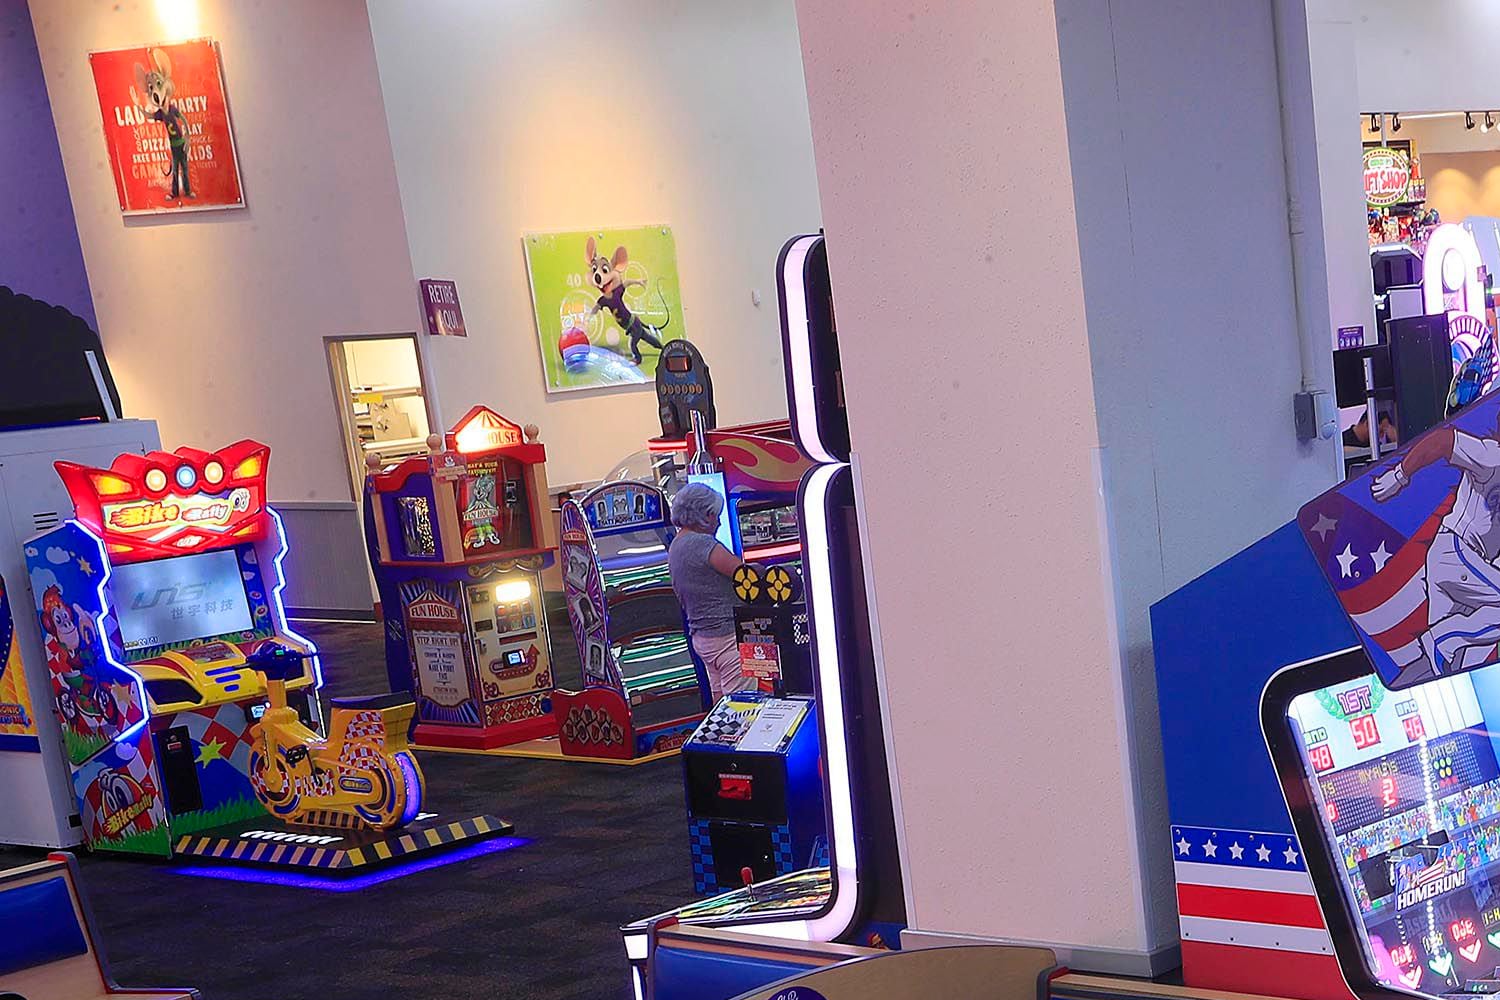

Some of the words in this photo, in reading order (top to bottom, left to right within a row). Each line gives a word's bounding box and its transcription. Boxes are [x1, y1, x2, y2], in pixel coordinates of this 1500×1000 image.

[141, 137, 172, 153] PIZZA
[1380, 170, 1407, 190] SHOP
[113, 503, 180, 527] Bike
[411, 606, 427, 617] FUN
[428, 604, 456, 618] HOUSE
[1336, 685, 1372, 715] 1ST
[1351, 716, 1379, 748] 50
[1309, 747, 1333, 771] 48
[1417, 740, 1460, 762] CUNTER
[1396, 869, 1467, 911] HOMERUN!
